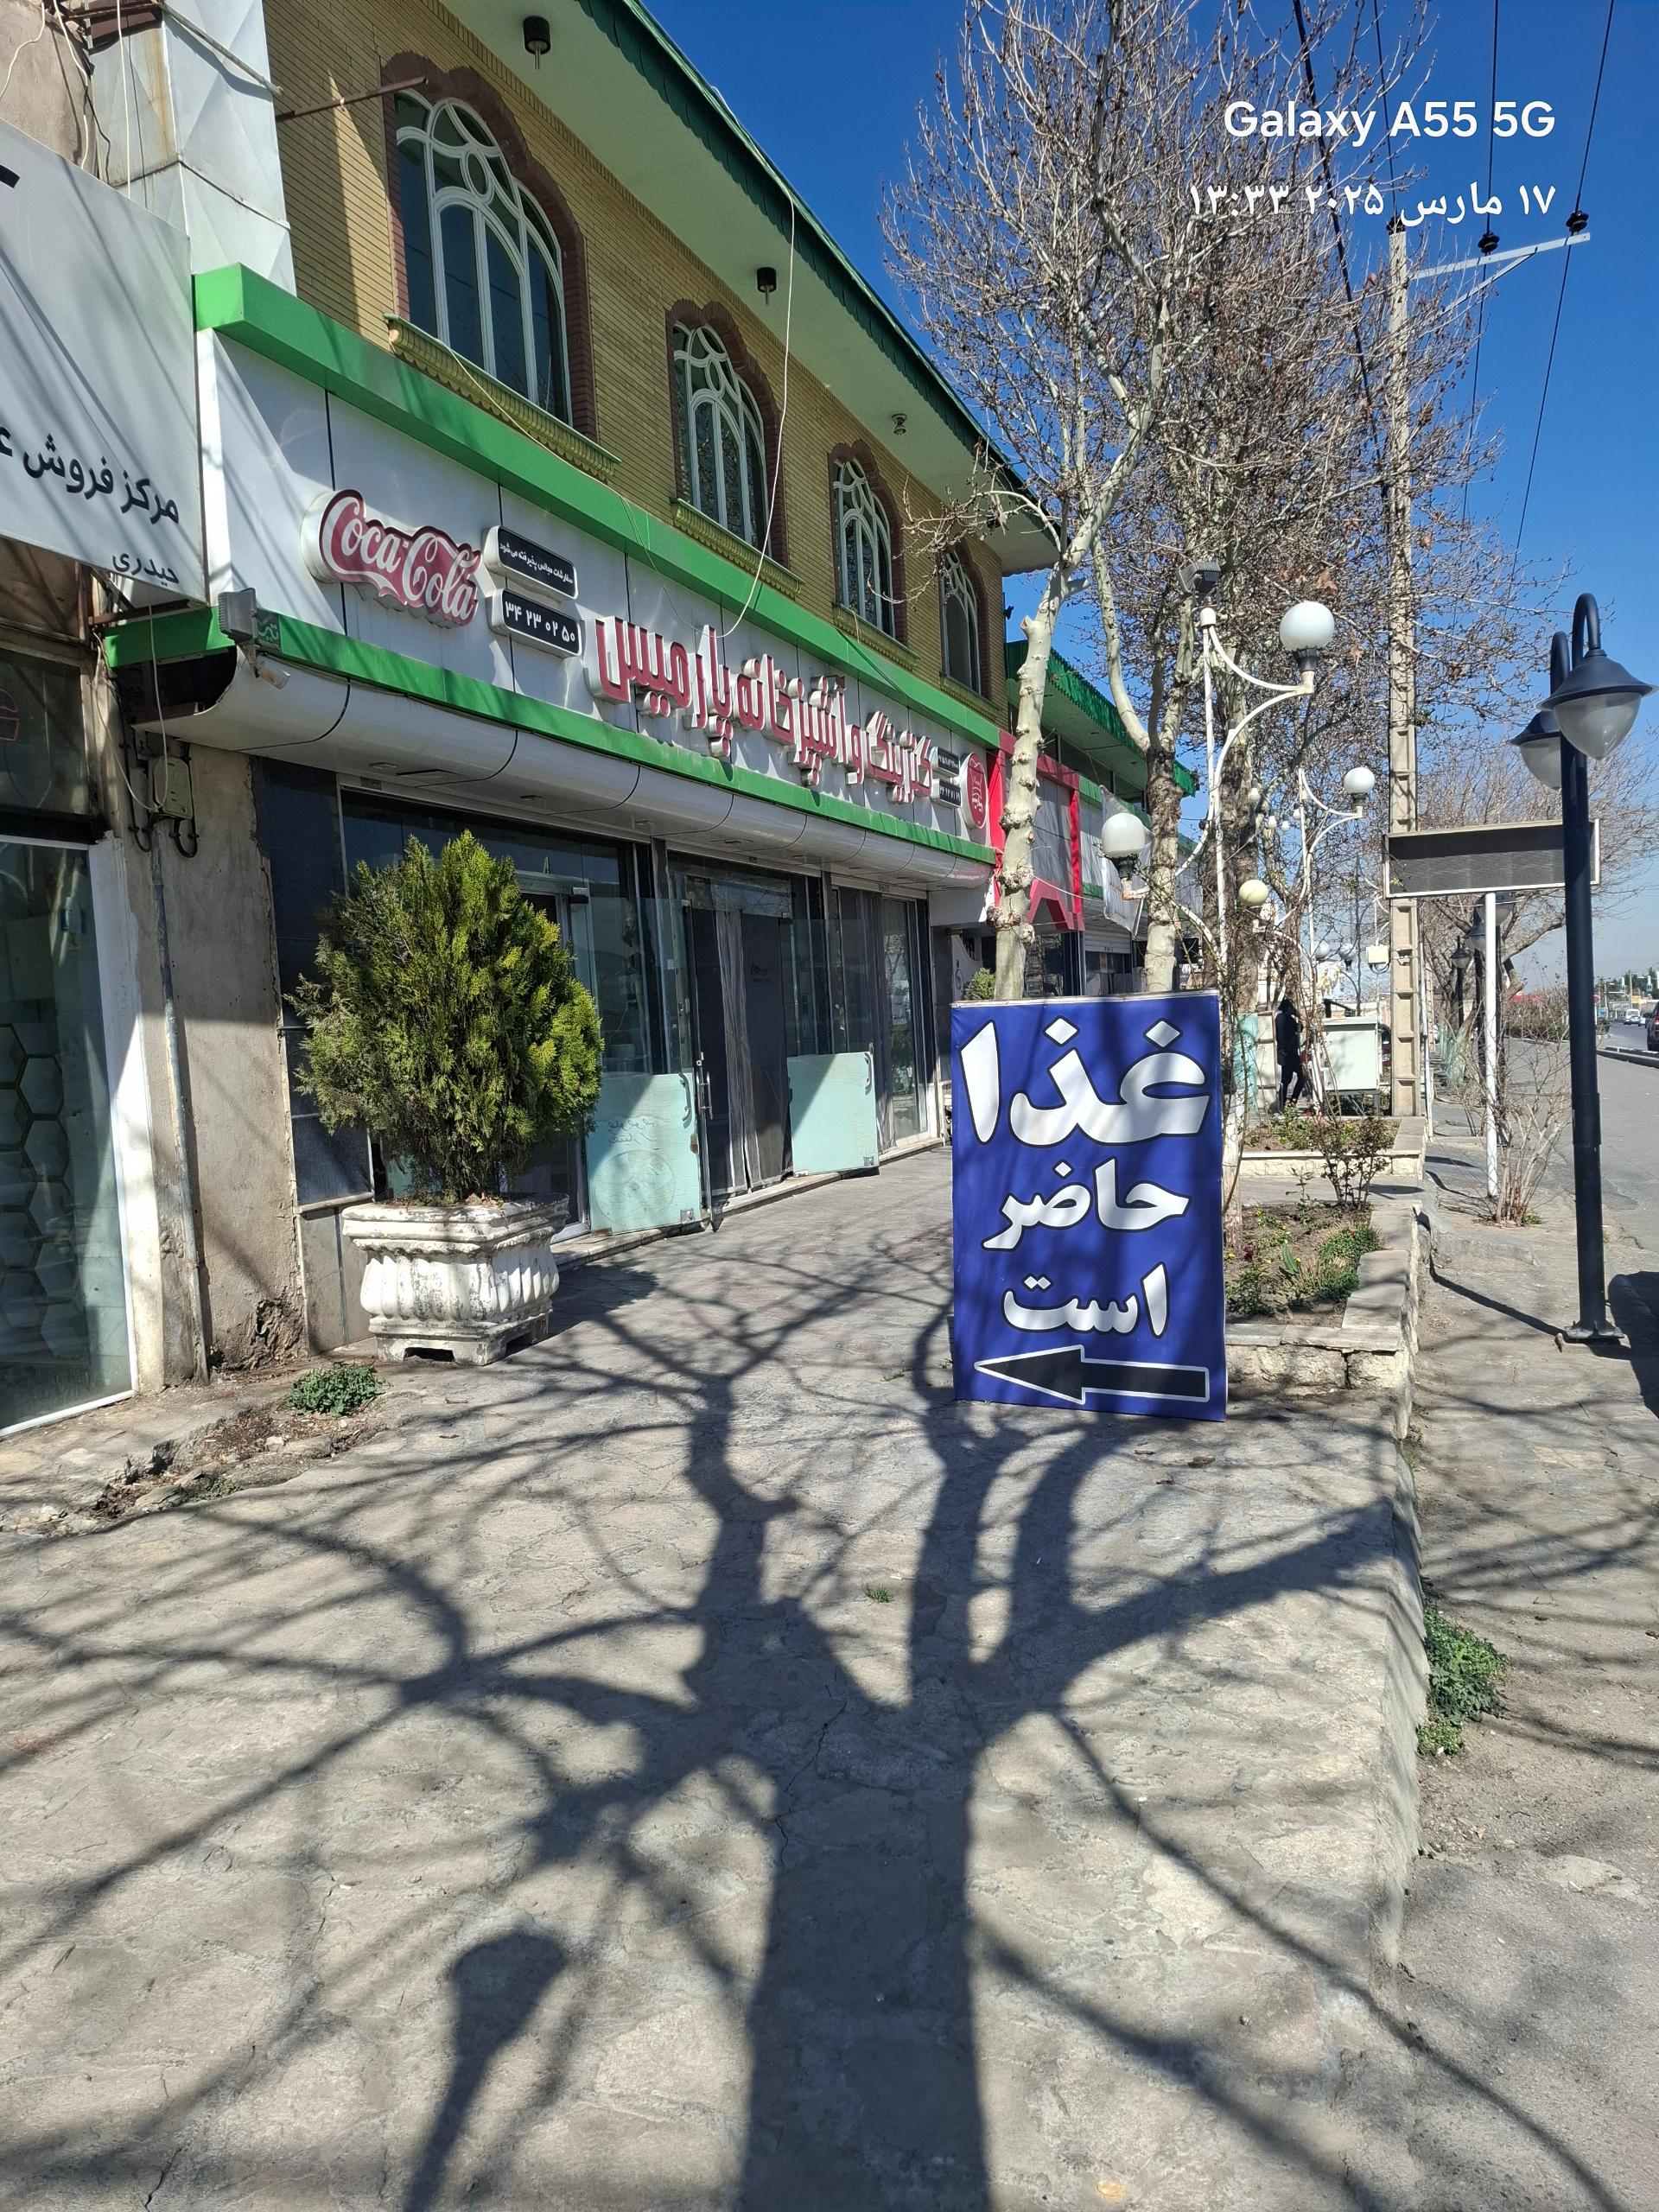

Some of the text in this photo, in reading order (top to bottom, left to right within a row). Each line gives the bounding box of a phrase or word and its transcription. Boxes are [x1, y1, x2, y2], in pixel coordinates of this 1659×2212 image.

[22, 433, 114, 500] فروش
[119, 469, 180, 525] مرکز
[111, 552, 181, 588] حیدری
[593, 615, 933, 804] کترینگ و آشپزخانه پارمیس
[959, 1016, 1211, 1147] غذا
[982, 1156, 1191, 1251] حاضر
[1001, 1262, 1170, 1338] است
